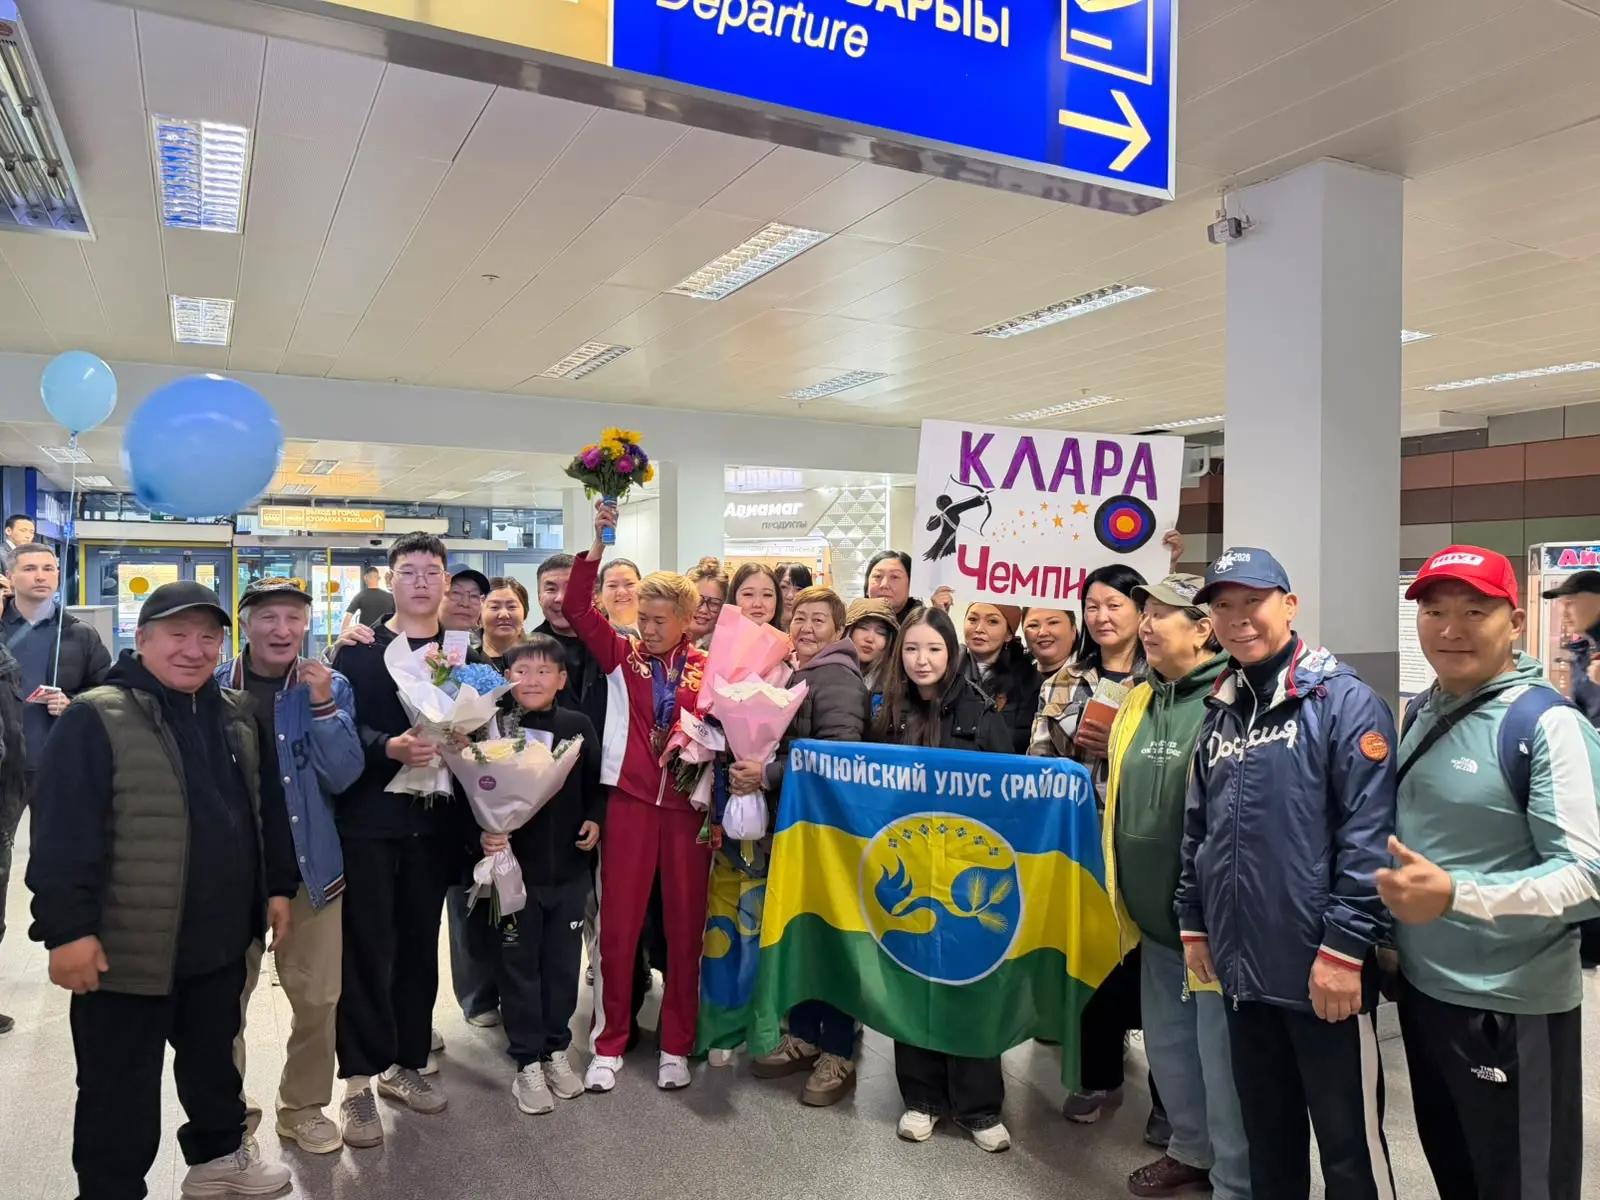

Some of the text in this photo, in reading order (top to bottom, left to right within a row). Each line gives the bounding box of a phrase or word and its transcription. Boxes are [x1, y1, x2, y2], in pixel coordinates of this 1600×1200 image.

[845, 0, 1010, 48] АРЫЫ
[959, 430, 1158, 501] КЛАРА
[723, 501, 804, 518] Авиамаг
[956, 543, 1086, 601] Чемпи
[790, 747, 1089, 806] ВИЛЮЙСКИЙ УЛУС (РАЙОН)
